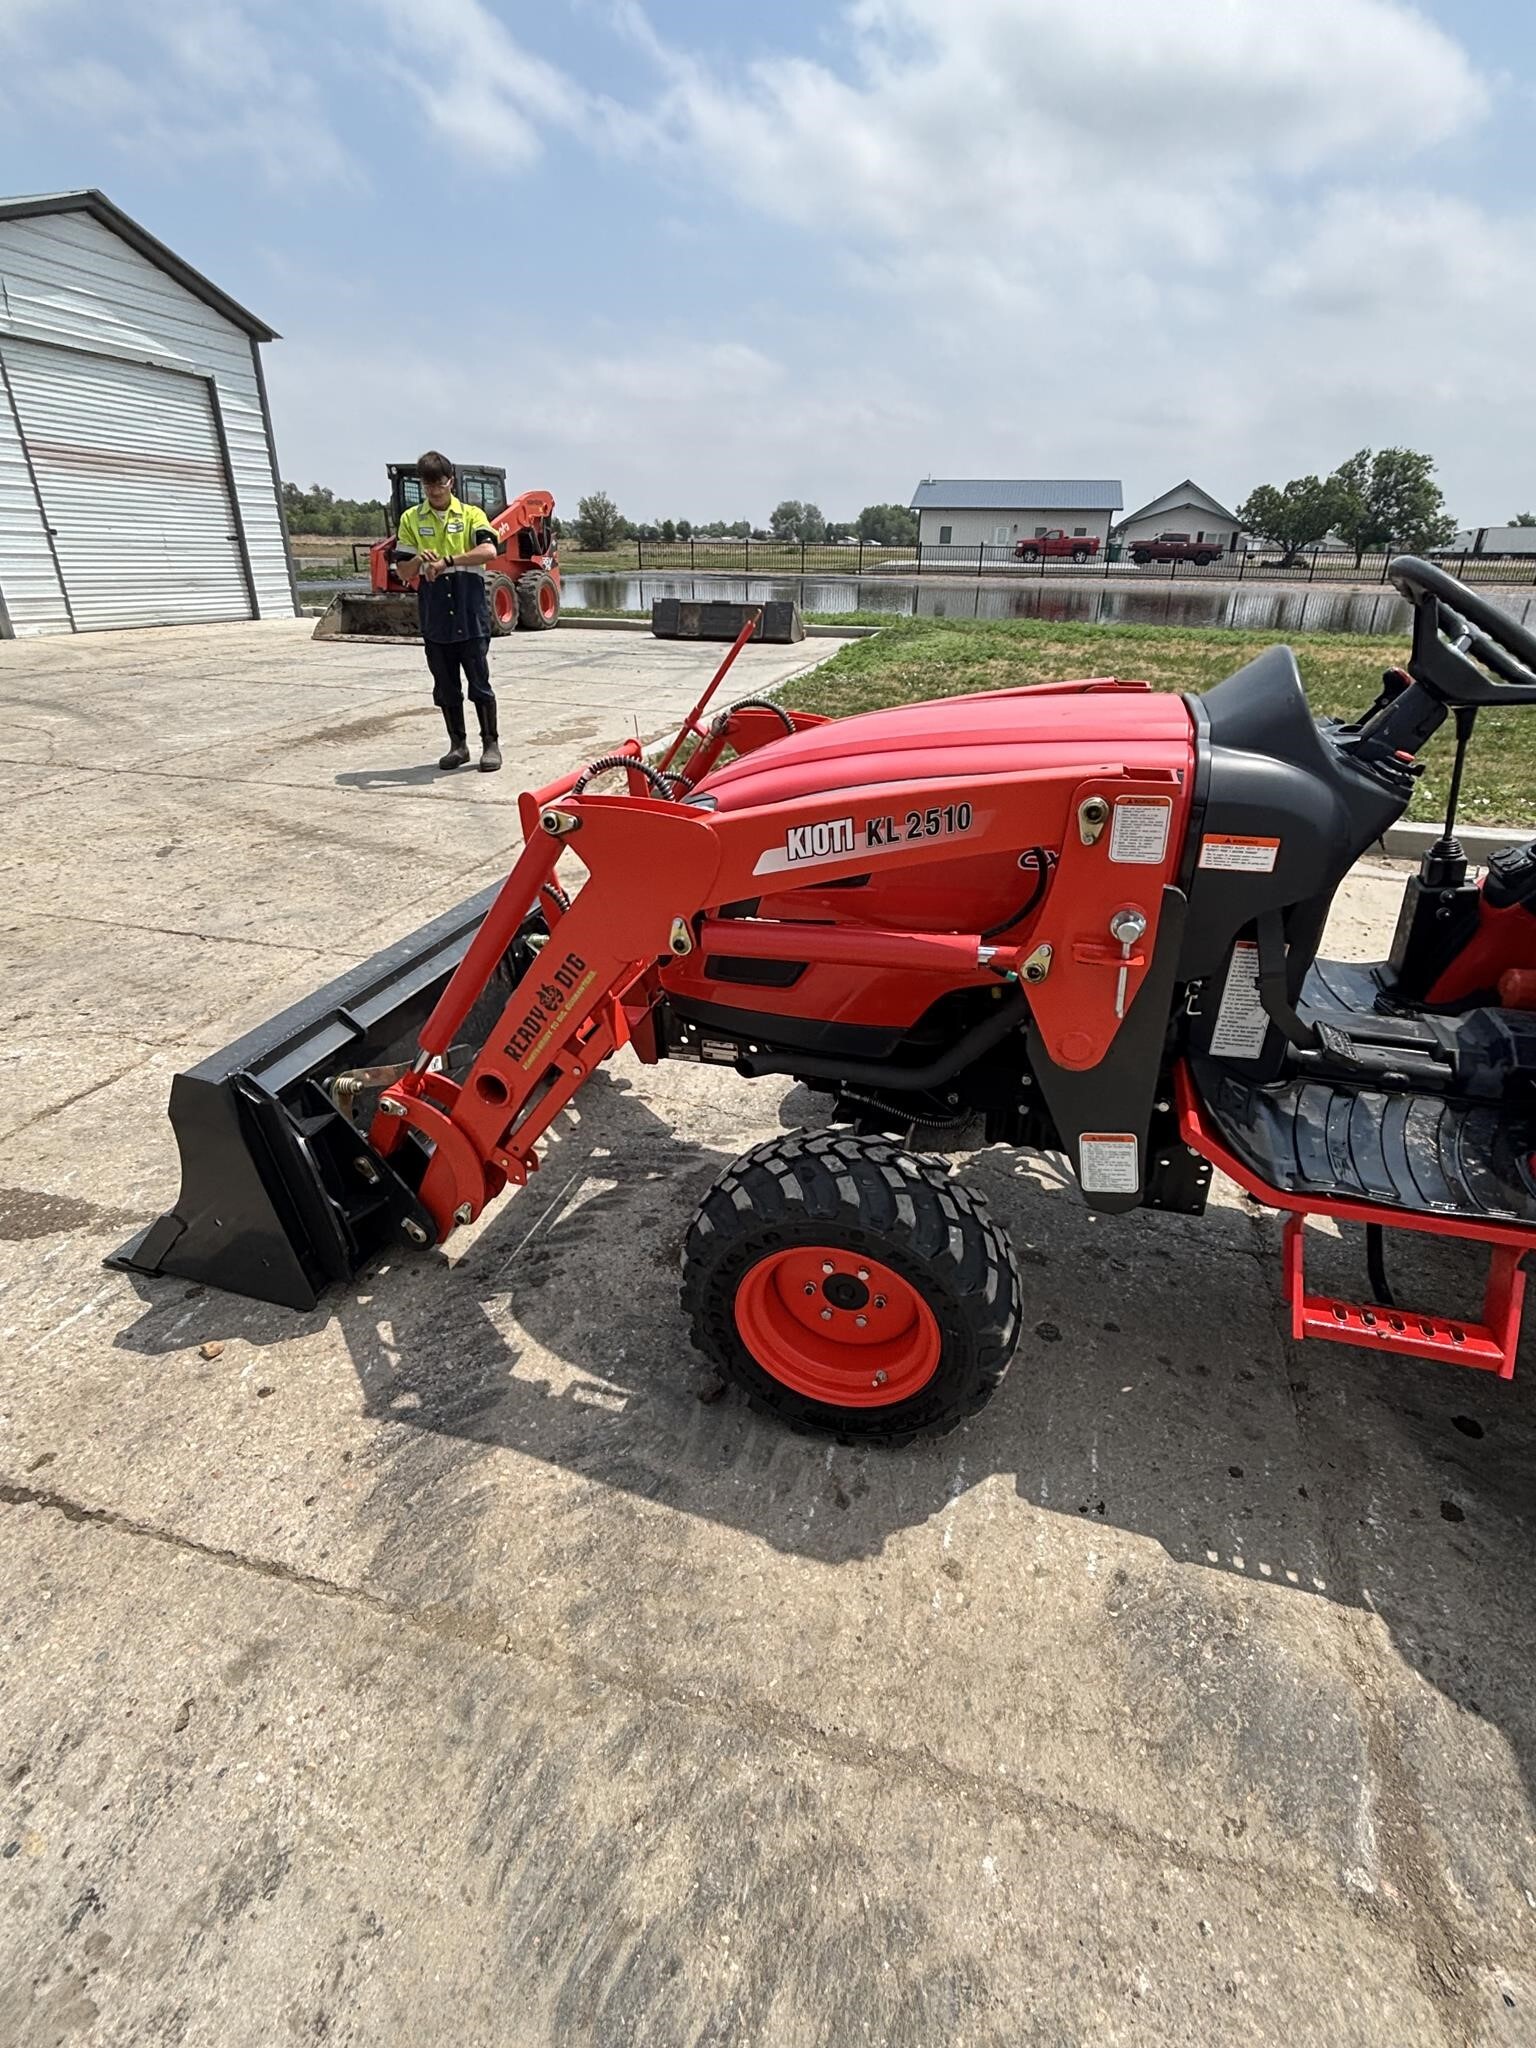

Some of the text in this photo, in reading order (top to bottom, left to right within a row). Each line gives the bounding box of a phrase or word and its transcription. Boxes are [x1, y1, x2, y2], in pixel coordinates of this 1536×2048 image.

[786, 801, 972, 861] KIOTI KL 2510
[503, 953, 586, 1061] READY DIG
